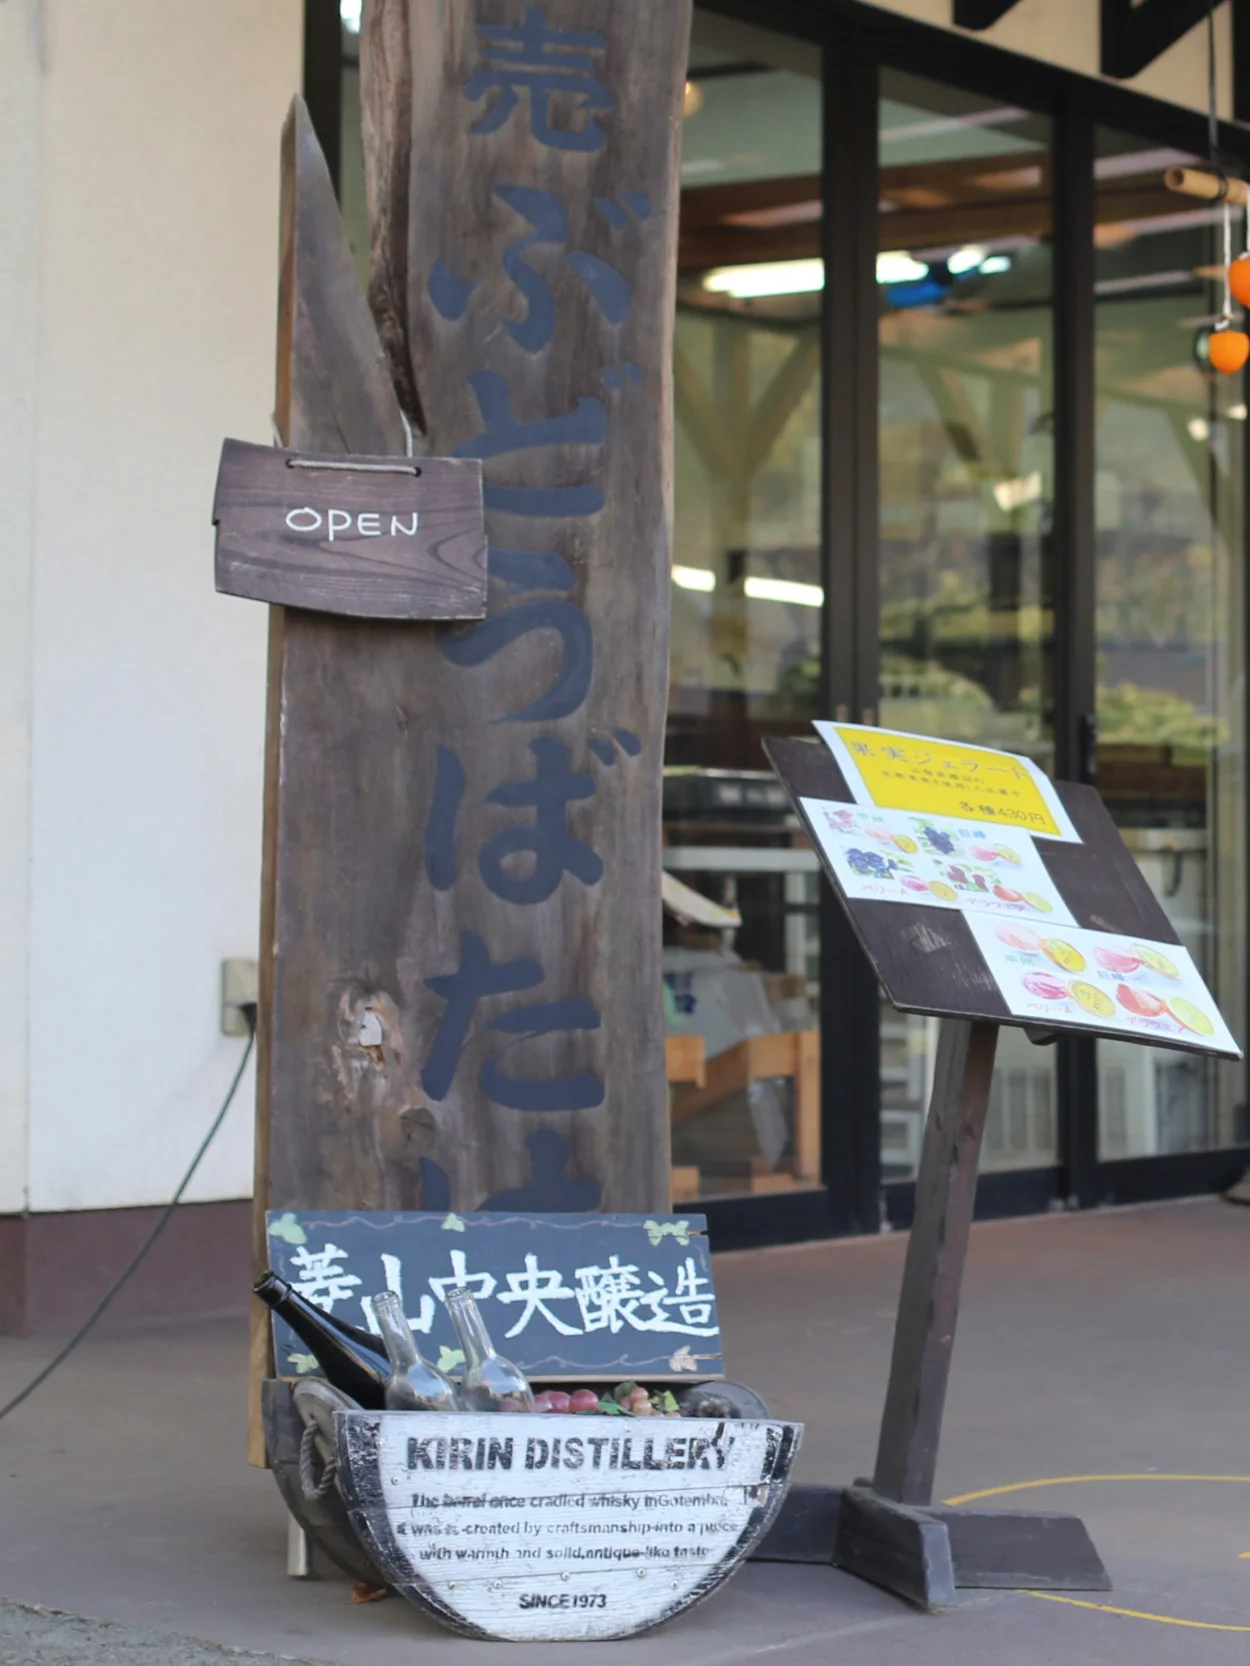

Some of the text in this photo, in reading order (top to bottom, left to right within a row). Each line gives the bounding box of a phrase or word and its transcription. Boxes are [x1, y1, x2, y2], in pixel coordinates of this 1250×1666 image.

[285, 507, 418, 541] OPEN
[851, 741, 1028, 780] 果実ジェラート
[407, 1437, 735, 1470] KIRIN DISTILLERY
[588, 1494, 640, 1510] whisky
[524, 1521, 543, 1536] by
[687, 1523, 695, 1533] a
[420, 1546, 451, 1561] with
[519, 1594, 607, 1609] SINCE 1973
